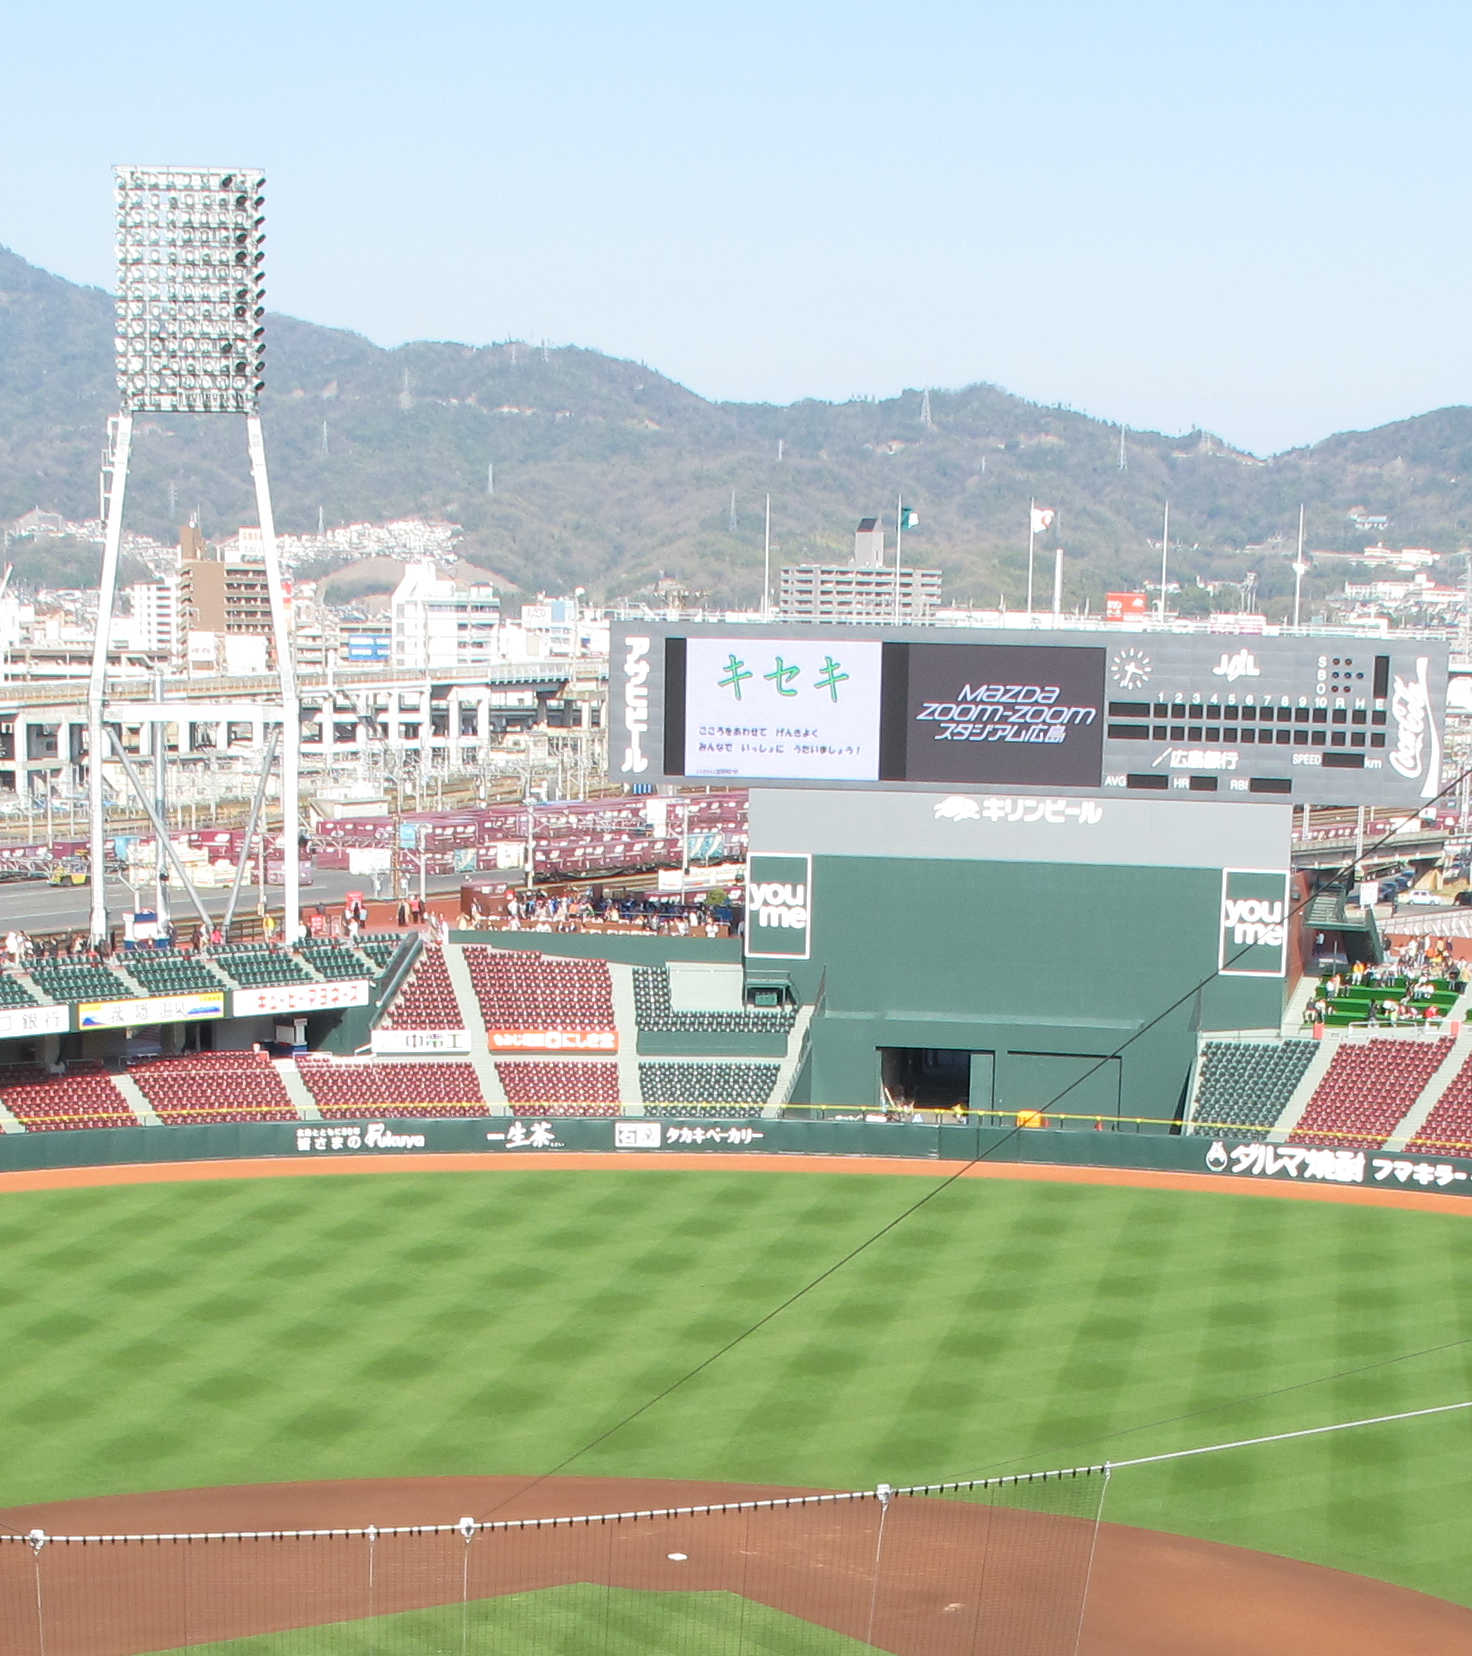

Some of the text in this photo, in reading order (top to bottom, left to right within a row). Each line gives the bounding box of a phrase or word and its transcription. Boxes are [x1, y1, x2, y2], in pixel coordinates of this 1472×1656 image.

[1213, 649, 1261, 681] JAL
[1317, 656, 1327, 668] S
[718, 654, 849, 702] キセキ
[1316, 669, 1327, 681] B
[621, 636, 650, 773] アサヒビール
[1158, 692, 1383, 710] 1 2 3 4 5 6 7 8 9 10 R H E
[916, 702, 1097, 725] zoom-zoom
[698, 727, 820, 739] こころをあわせて げんきよく
[934, 723, 1067, 743] スタジアム広島
[698, 742, 734, 753] みんなで
[741, 743, 785, 754] いっしょに
[1170, 749, 1239, 770] 広島銀行
[1292, 753, 1321, 766] SPEED
[1364, 757, 1382, 769] km
[1104, 775, 1126, 787] AVG
[1173, 778, 1189, 789] HR
[1230, 779, 1249, 791] RBI
[982, 797, 1103, 824] キリンビール
[749, 881, 804, 911] you
[758, 904, 806, 930] me
[1226, 898, 1282, 928] you
[1234, 921, 1284, 946] me
[666, 1127, 764, 1145] タカキベーカリー
[1372, 1159, 1468, 1187] フマキラー
